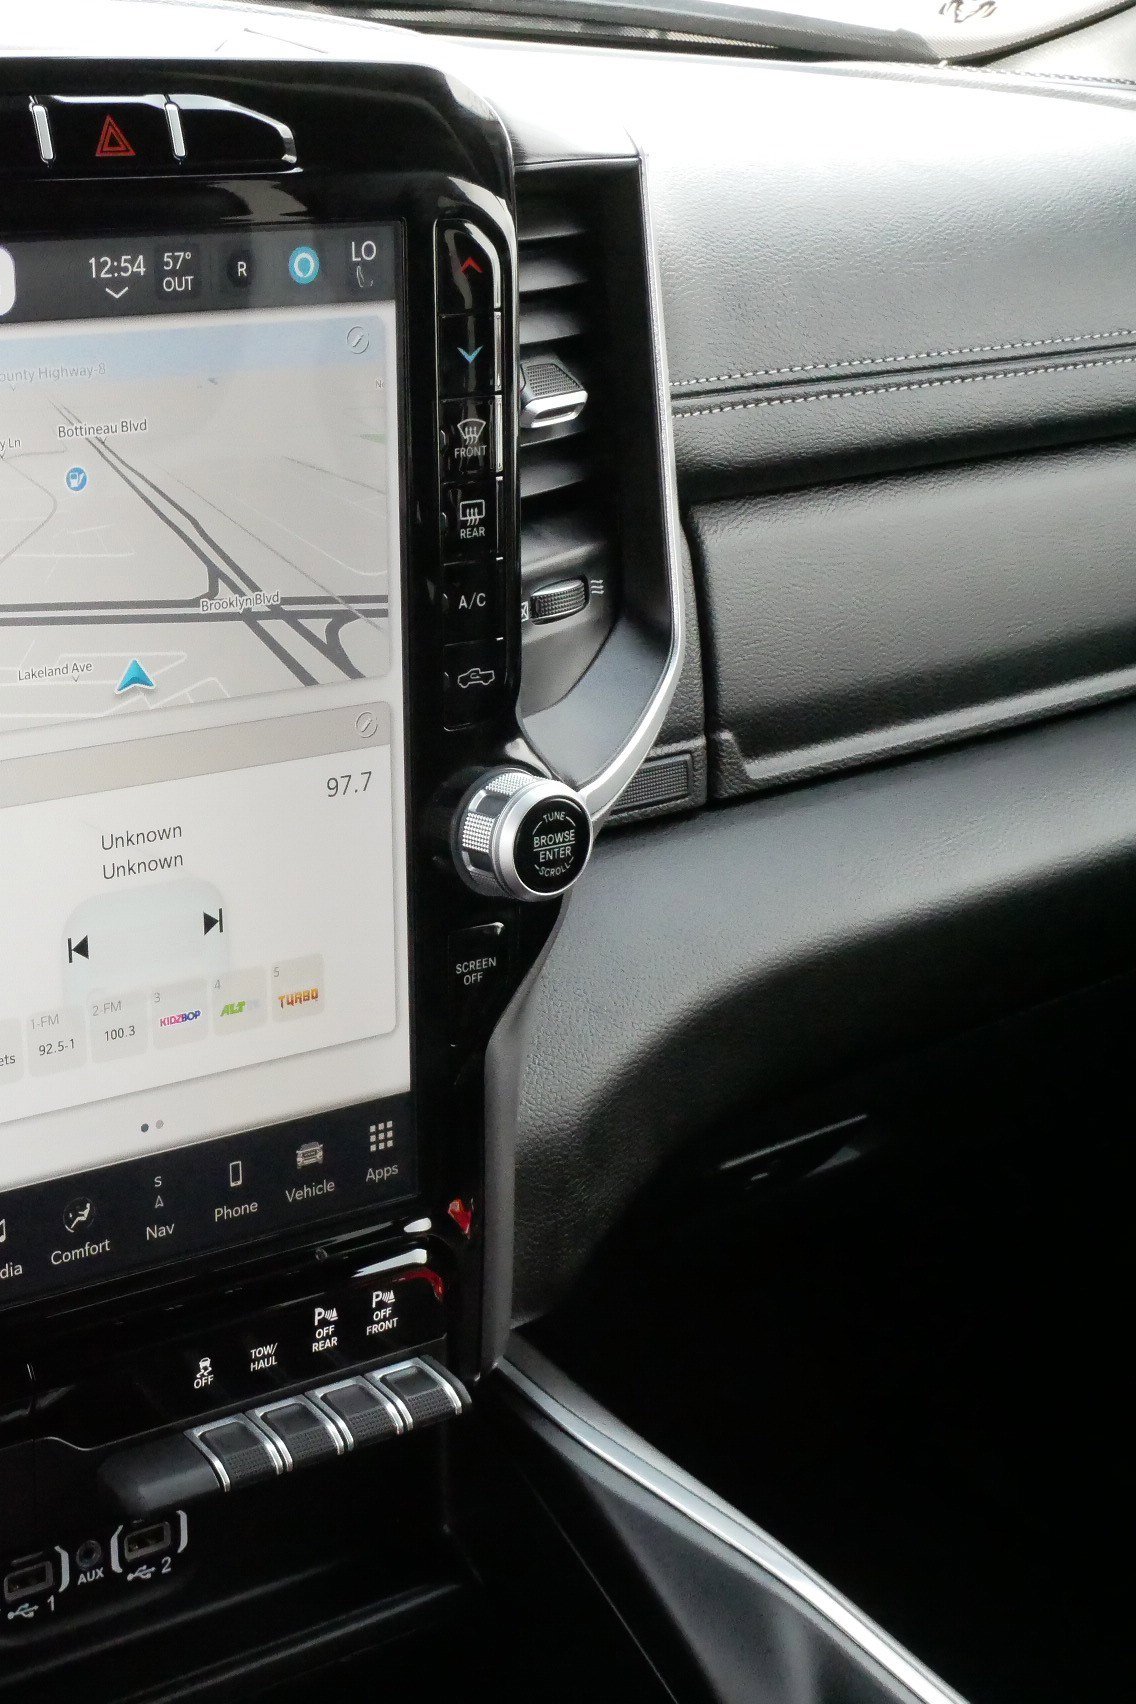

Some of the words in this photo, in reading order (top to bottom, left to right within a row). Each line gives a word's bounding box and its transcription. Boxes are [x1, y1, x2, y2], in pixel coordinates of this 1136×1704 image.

[352, 241, 377, 262] LO
[89, 255, 146, 278] 12:54
[163, 252, 192, 270] 57°
[237, 261, 248, 277] R
[163, 276, 194, 292] OUT
[38, 362, 107, 380] Highway-8
[58, 422, 118, 438] Bottineau
[121, 419, 148, 433] Blvd
[9, 438, 21, 448] Ln
[454, 445, 487, 459] FRONT
[460, 526, 486, 540] REAR
[201, 593, 253, 613] Brooklyn
[255, 591, 280, 606] Blvd
[458, 592, 487, 610] A/C
[18, 664, 69, 682] Lakeland
[71, 661, 93, 674] Ave
[326, 771, 372, 798] 97.7
[542, 811, 566, 824] TUNE
[101, 824, 183, 851] Unknown
[533, 829, 576, 848] BROWSE
[539, 846, 572, 863] ENTER
[102, 852, 184, 880] Unknown
[538, 862, 571, 877] SCROLL
[455, 956, 497, 975] SCREEN
[464, 971, 484, 986] OFF
[153, 991, 162, 1003] 3
[104, 1025, 136, 1042] 100.3
[38, 1038, 75, 1056] 92.5-1
[365, 1163, 399, 1182] Apps
[285, 1179, 336, 1203] Vehicle
[214, 1201, 259, 1222] Phone
[146, 1223, 175, 1240] Nav
[51, 1238, 111, 1265] Comfort
[373, 1307, 393, 1321] OFF
[316, 1325, 335, 1339] OFF
[366, 1318, 399, 1336] FRONT
[250, 1342, 278, 1359] TOW/
[312, 1336, 338, 1352] REAR
[250, 1355, 278, 1372] HAUL
[193, 1375, 214, 1389] OFF
[161, 1557, 172, 1574] 2
[77, 1567, 105, 1585] AUX
[47, 1595, 55, 1611] 1
